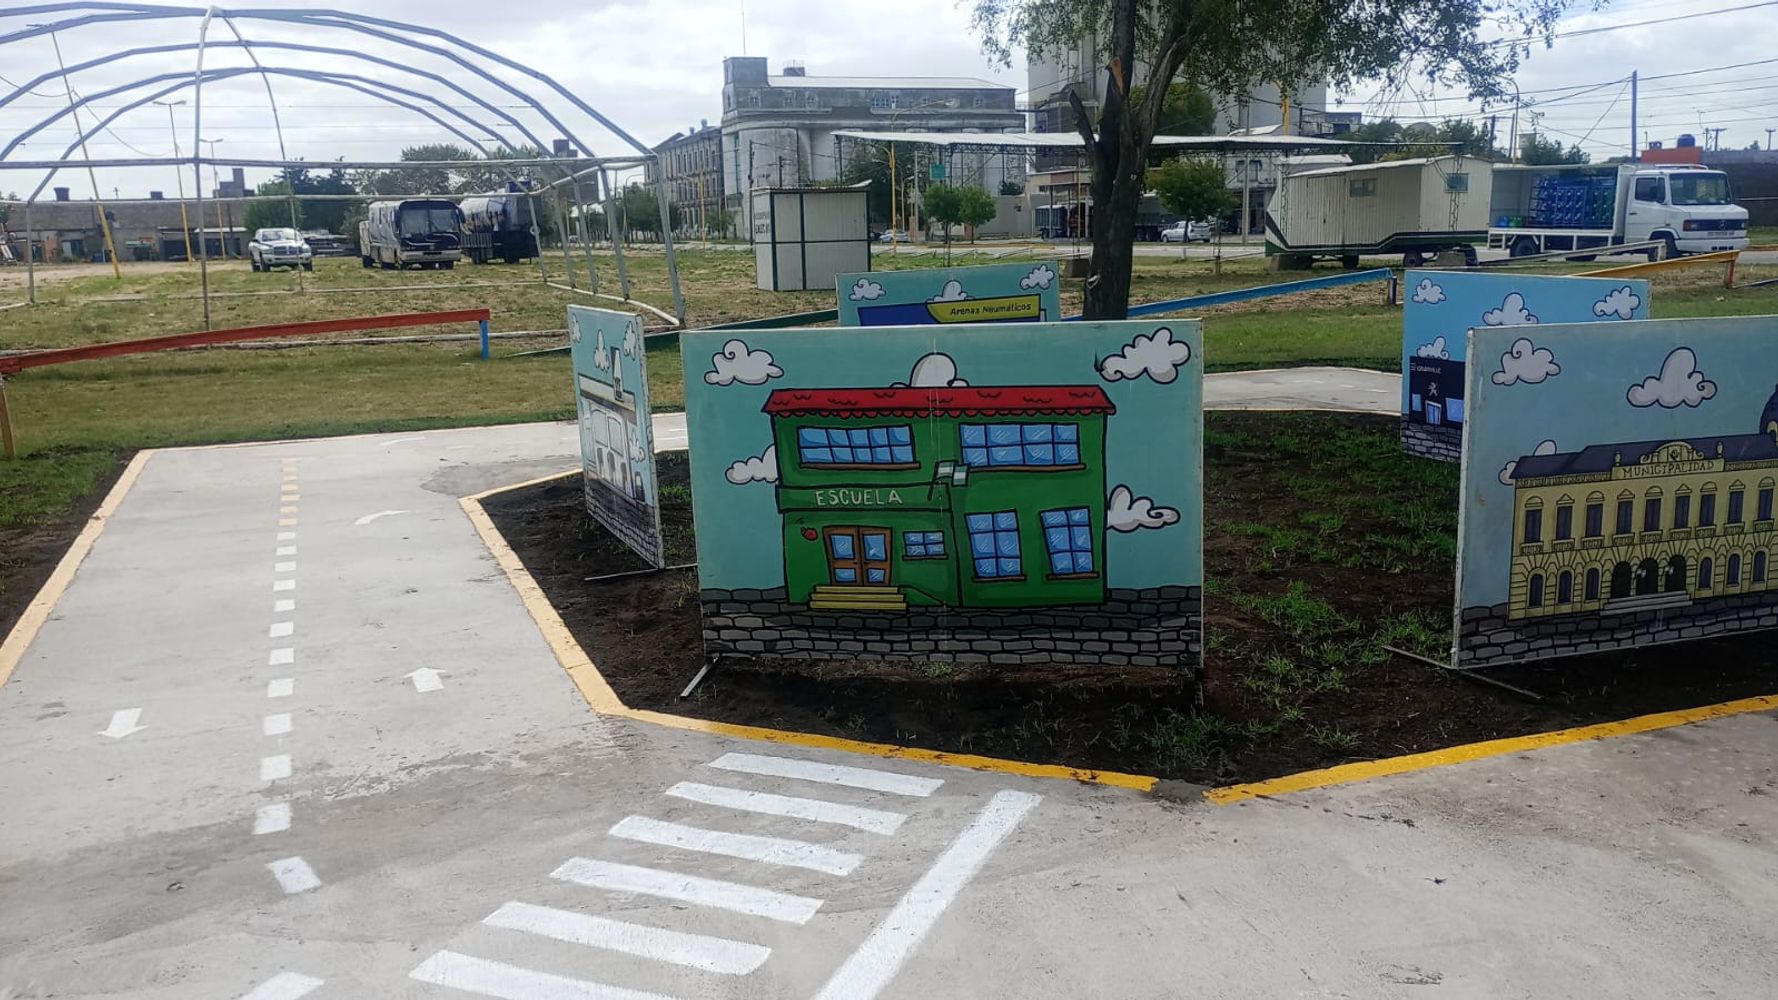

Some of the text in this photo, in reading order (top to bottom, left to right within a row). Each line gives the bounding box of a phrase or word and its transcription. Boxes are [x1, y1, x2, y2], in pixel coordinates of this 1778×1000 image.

[950, 303, 1032, 316] Arenas Neumáticos
[815, 489, 903, 506] ESCUELA
